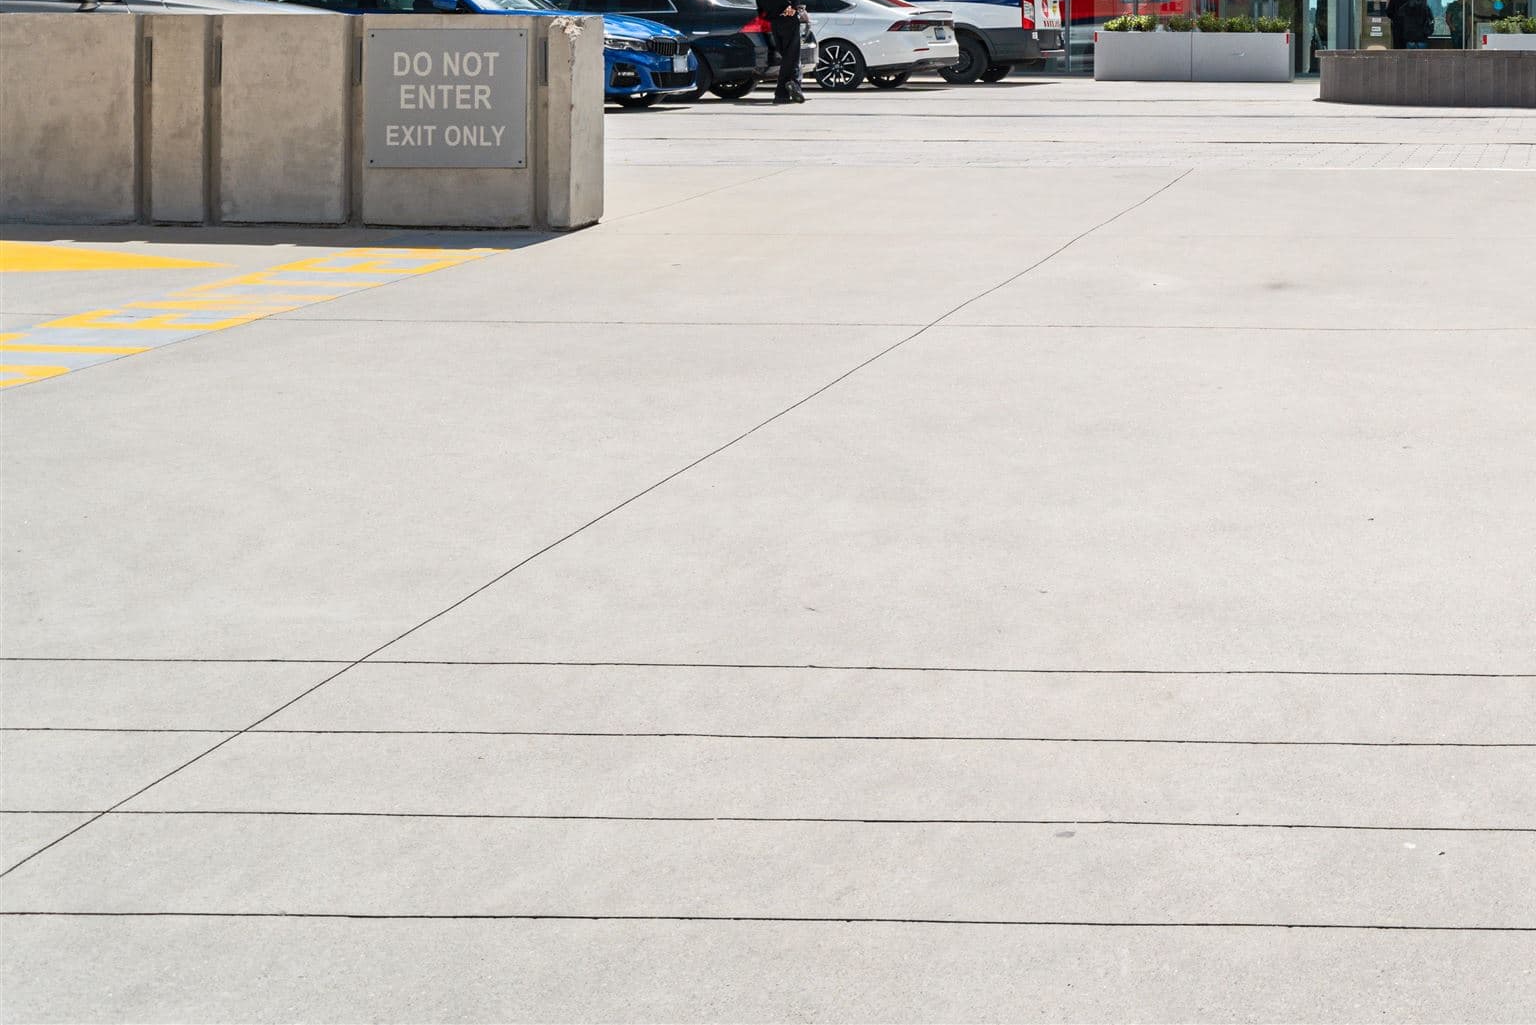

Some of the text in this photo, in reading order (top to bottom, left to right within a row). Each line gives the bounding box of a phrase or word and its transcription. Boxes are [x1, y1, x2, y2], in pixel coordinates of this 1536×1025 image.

[393, 51, 500, 77] DO NOT
[400, 84, 492, 110] ENTER
[386, 125, 506, 147] EXIT ONLY
